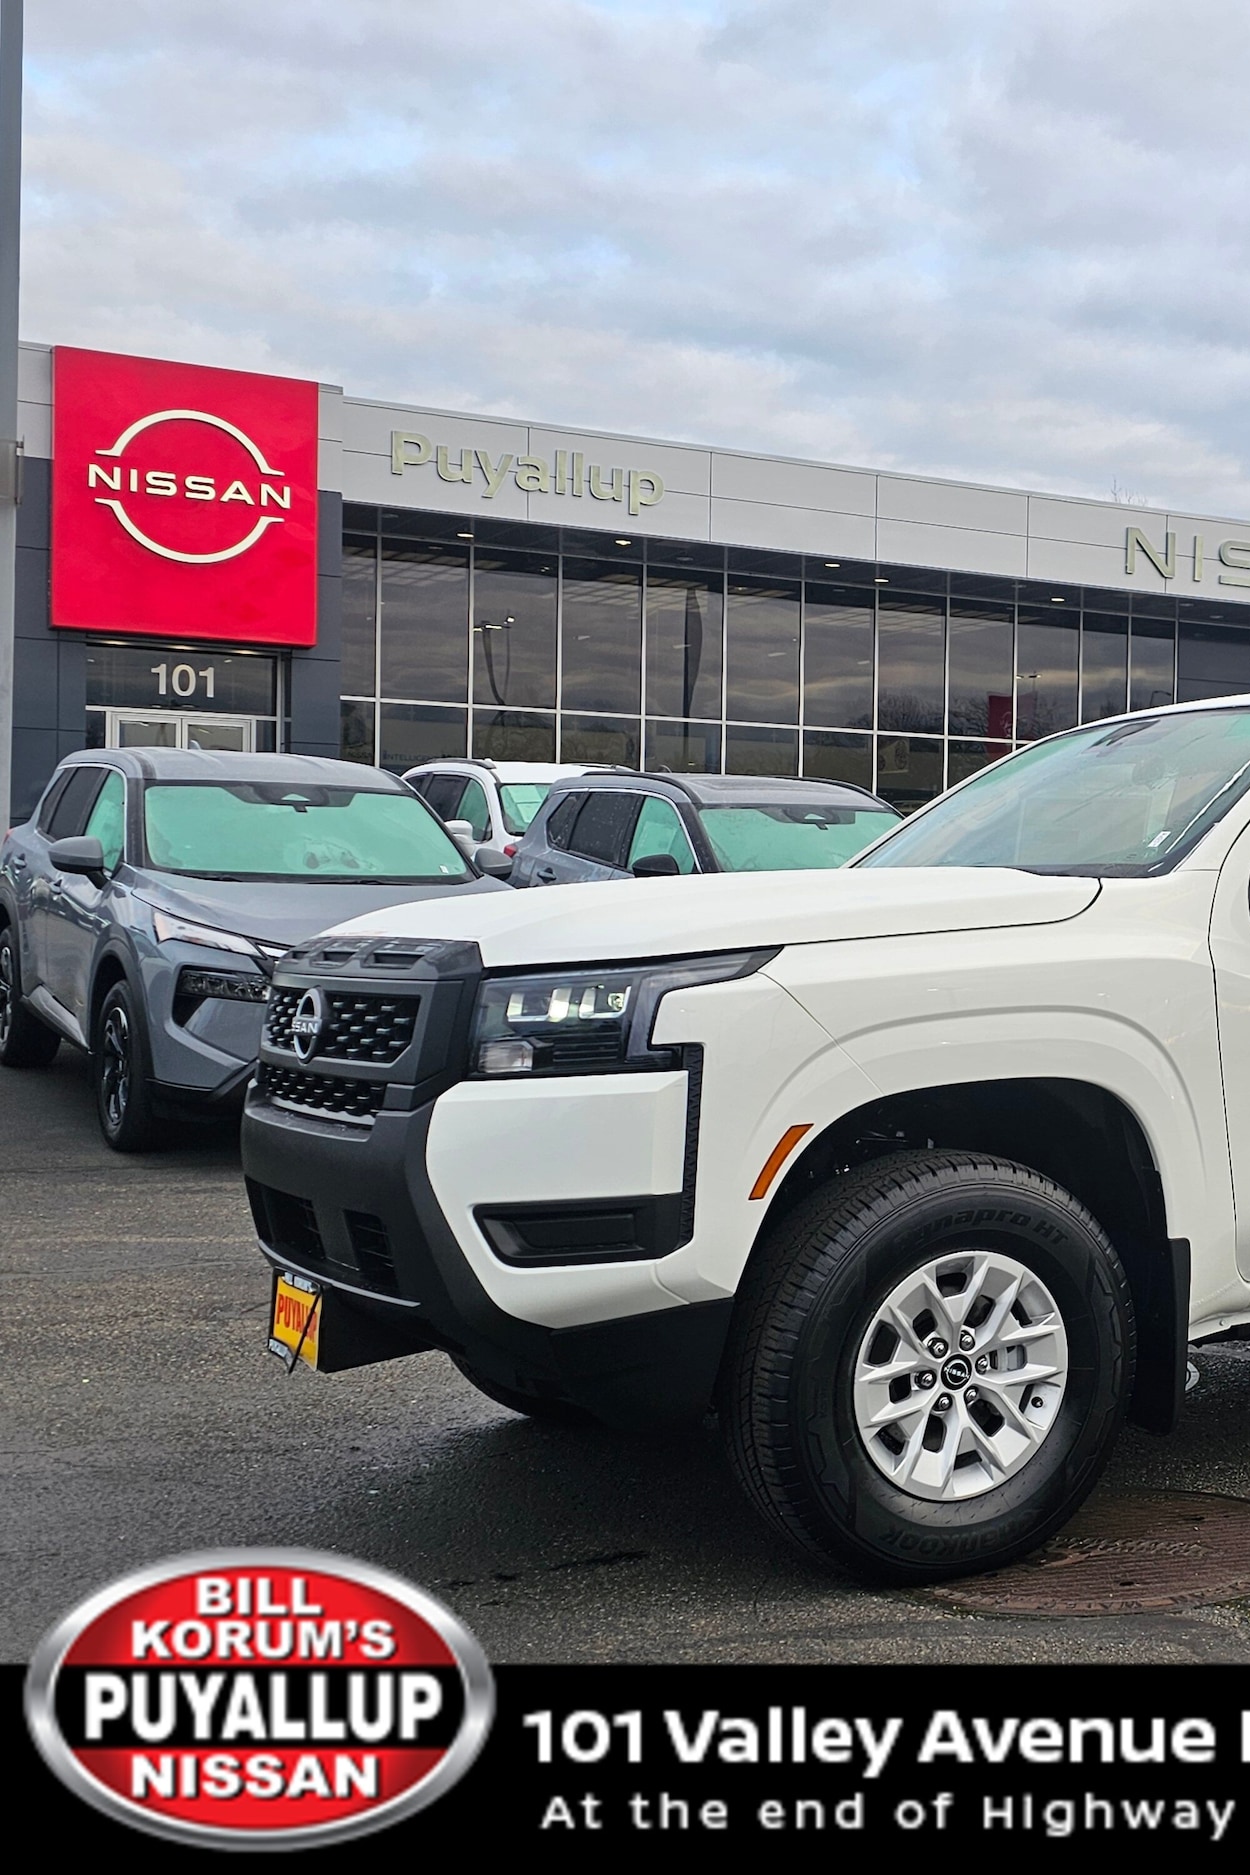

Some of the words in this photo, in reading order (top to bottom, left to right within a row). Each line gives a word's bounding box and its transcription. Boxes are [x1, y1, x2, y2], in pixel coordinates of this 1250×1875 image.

[88, 464, 291, 509] NISSAN
[391, 430, 665, 515] Puyallup
[151, 663, 216, 698] 101
